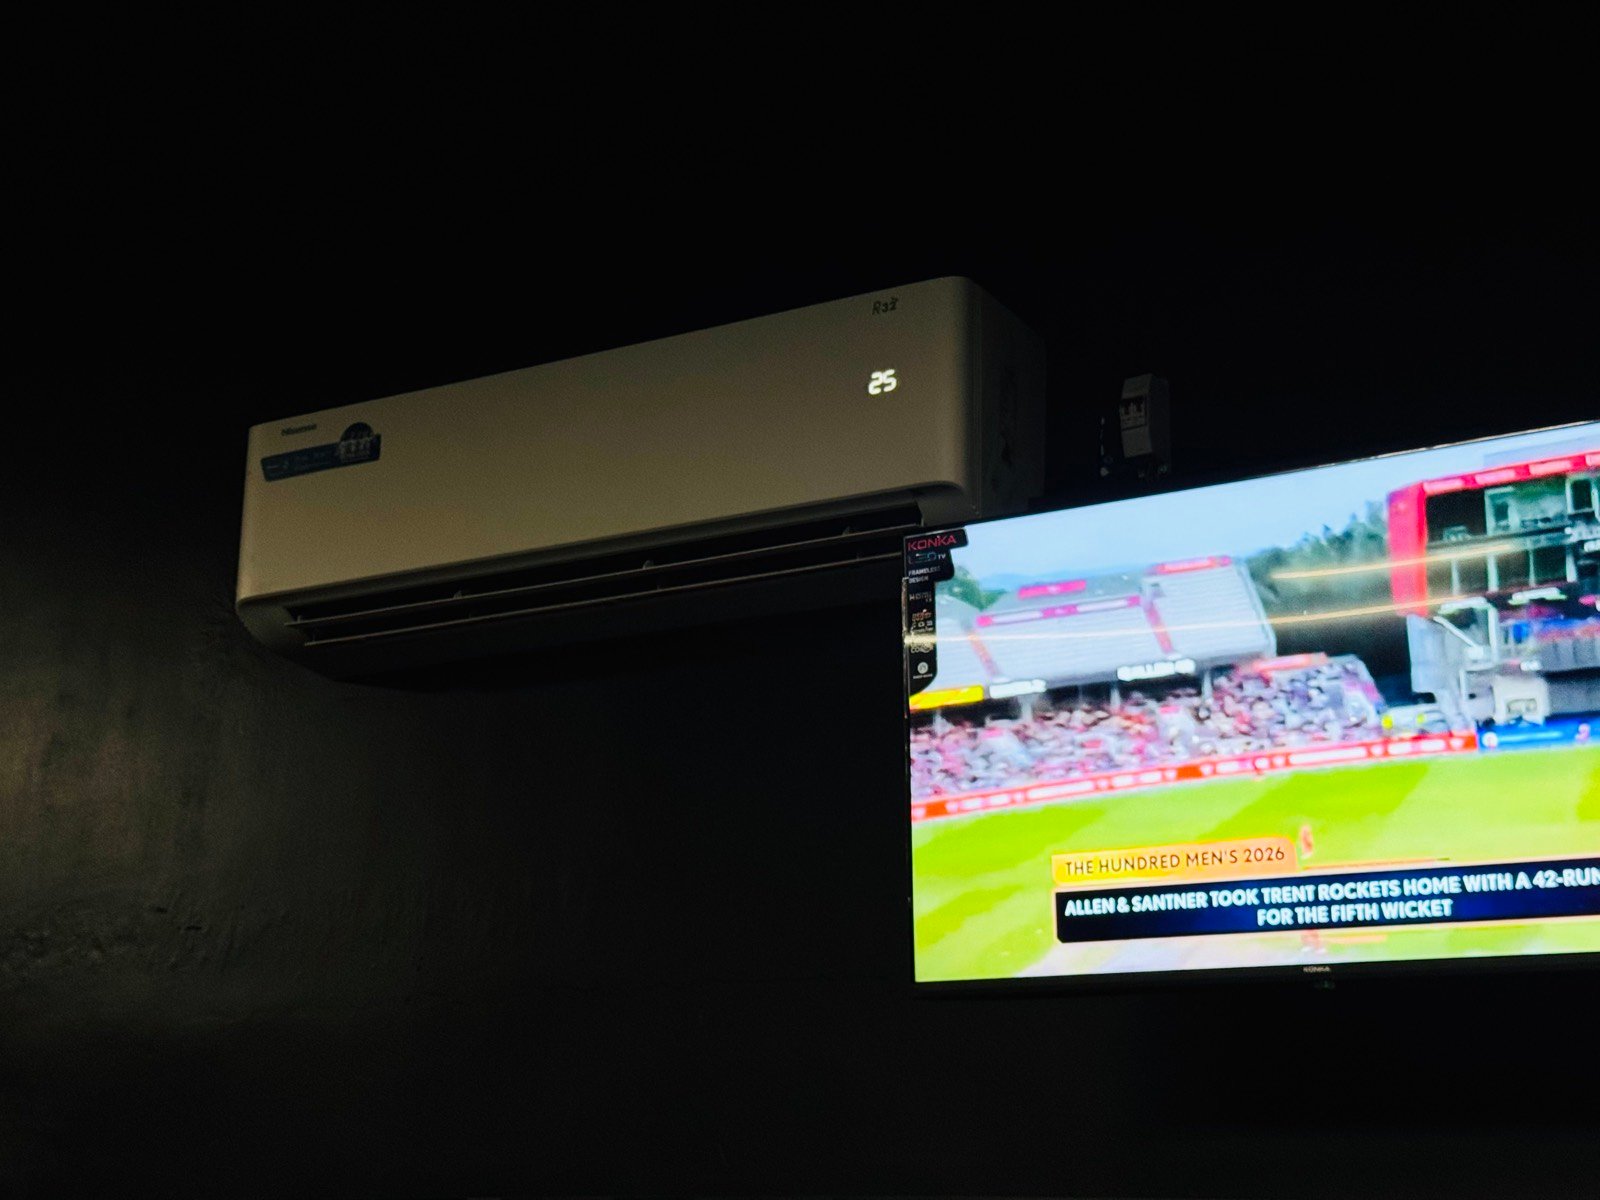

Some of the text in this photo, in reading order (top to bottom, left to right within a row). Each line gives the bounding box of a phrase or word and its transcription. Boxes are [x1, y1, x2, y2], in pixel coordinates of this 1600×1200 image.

[868, 369, 897, 395] 25
[907, 534, 957, 551] KONKA
[1065, 846, 1285, 876] THE HUNDRED MEN'S 2026
[1064, 896, 1117, 917] ALLEN
[1117, 896, 1132, 914] &
[1132, 891, 1210, 913] SANTNER
[1209, 888, 1260, 908] TOOK
[1261, 884, 1317, 905] TRENT
[1317, 879, 1402, 902] ROCKETS
[1403, 875, 1462, 897] HOME
[1462, 872, 1514, 893] WITH
[1515, 871, 1533, 890] A
[1257, 898, 1454, 927] FOR THE FIFTH WICKET
